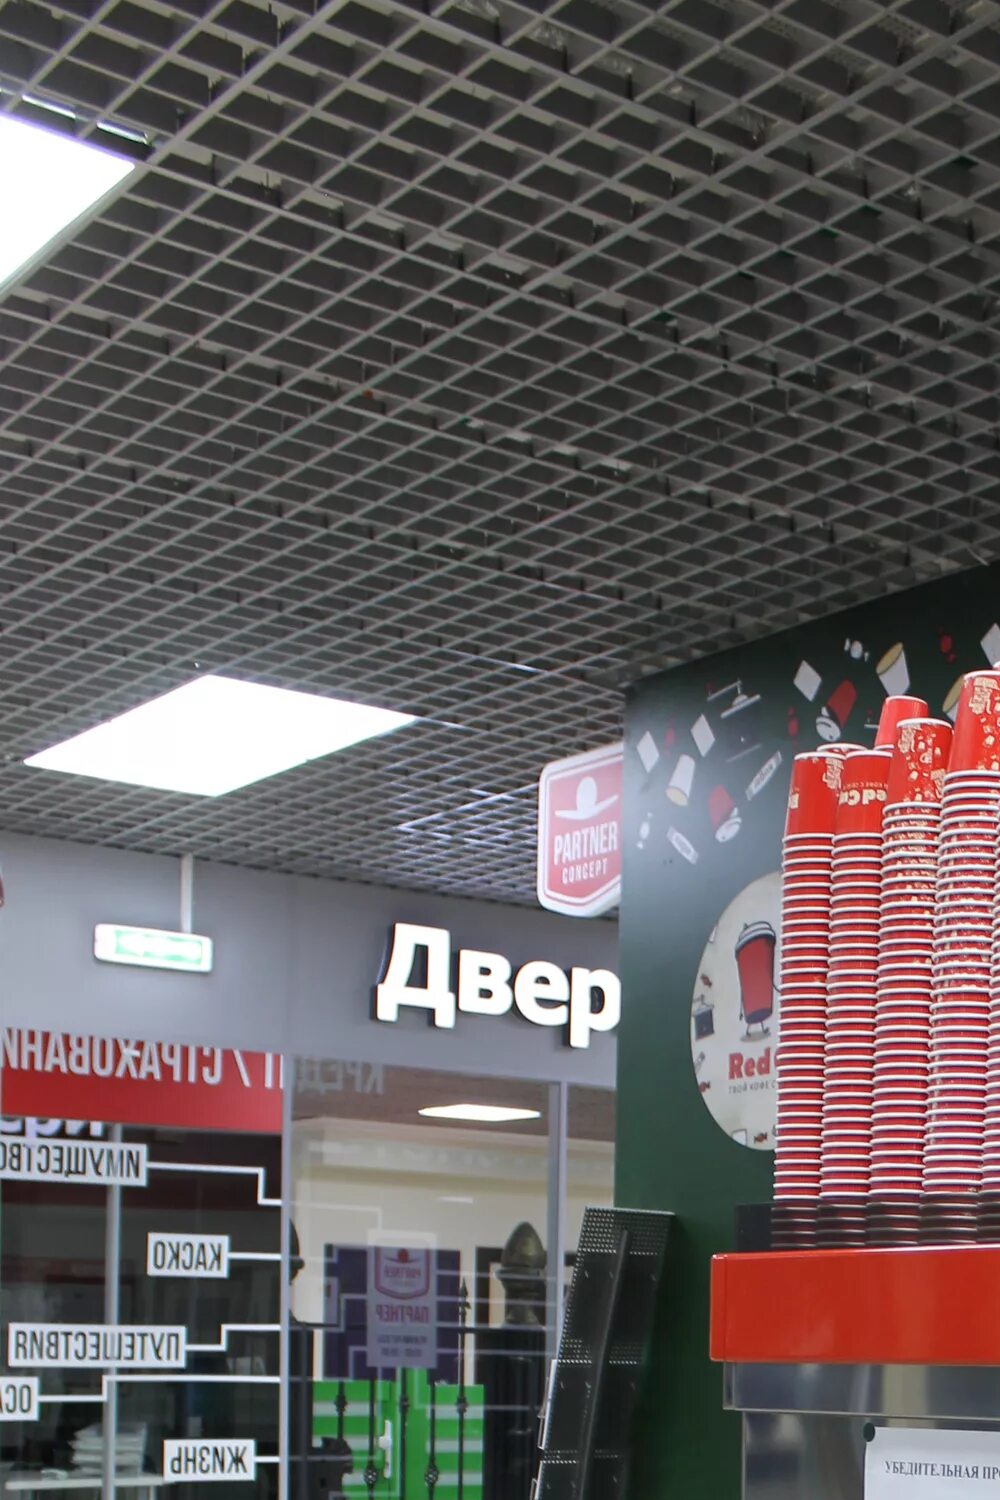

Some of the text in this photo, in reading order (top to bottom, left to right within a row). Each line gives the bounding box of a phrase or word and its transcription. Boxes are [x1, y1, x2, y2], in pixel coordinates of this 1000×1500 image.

[554, 821, 618, 866] PARTNER
[562, 858, 608, 885] CONCEPT
[377, 922, 621, 1048] Двер
[727, 1046, 771, 1081] Red
[885, 1460, 979, 1479] УБЕДИТЕЛЬНАЯ
